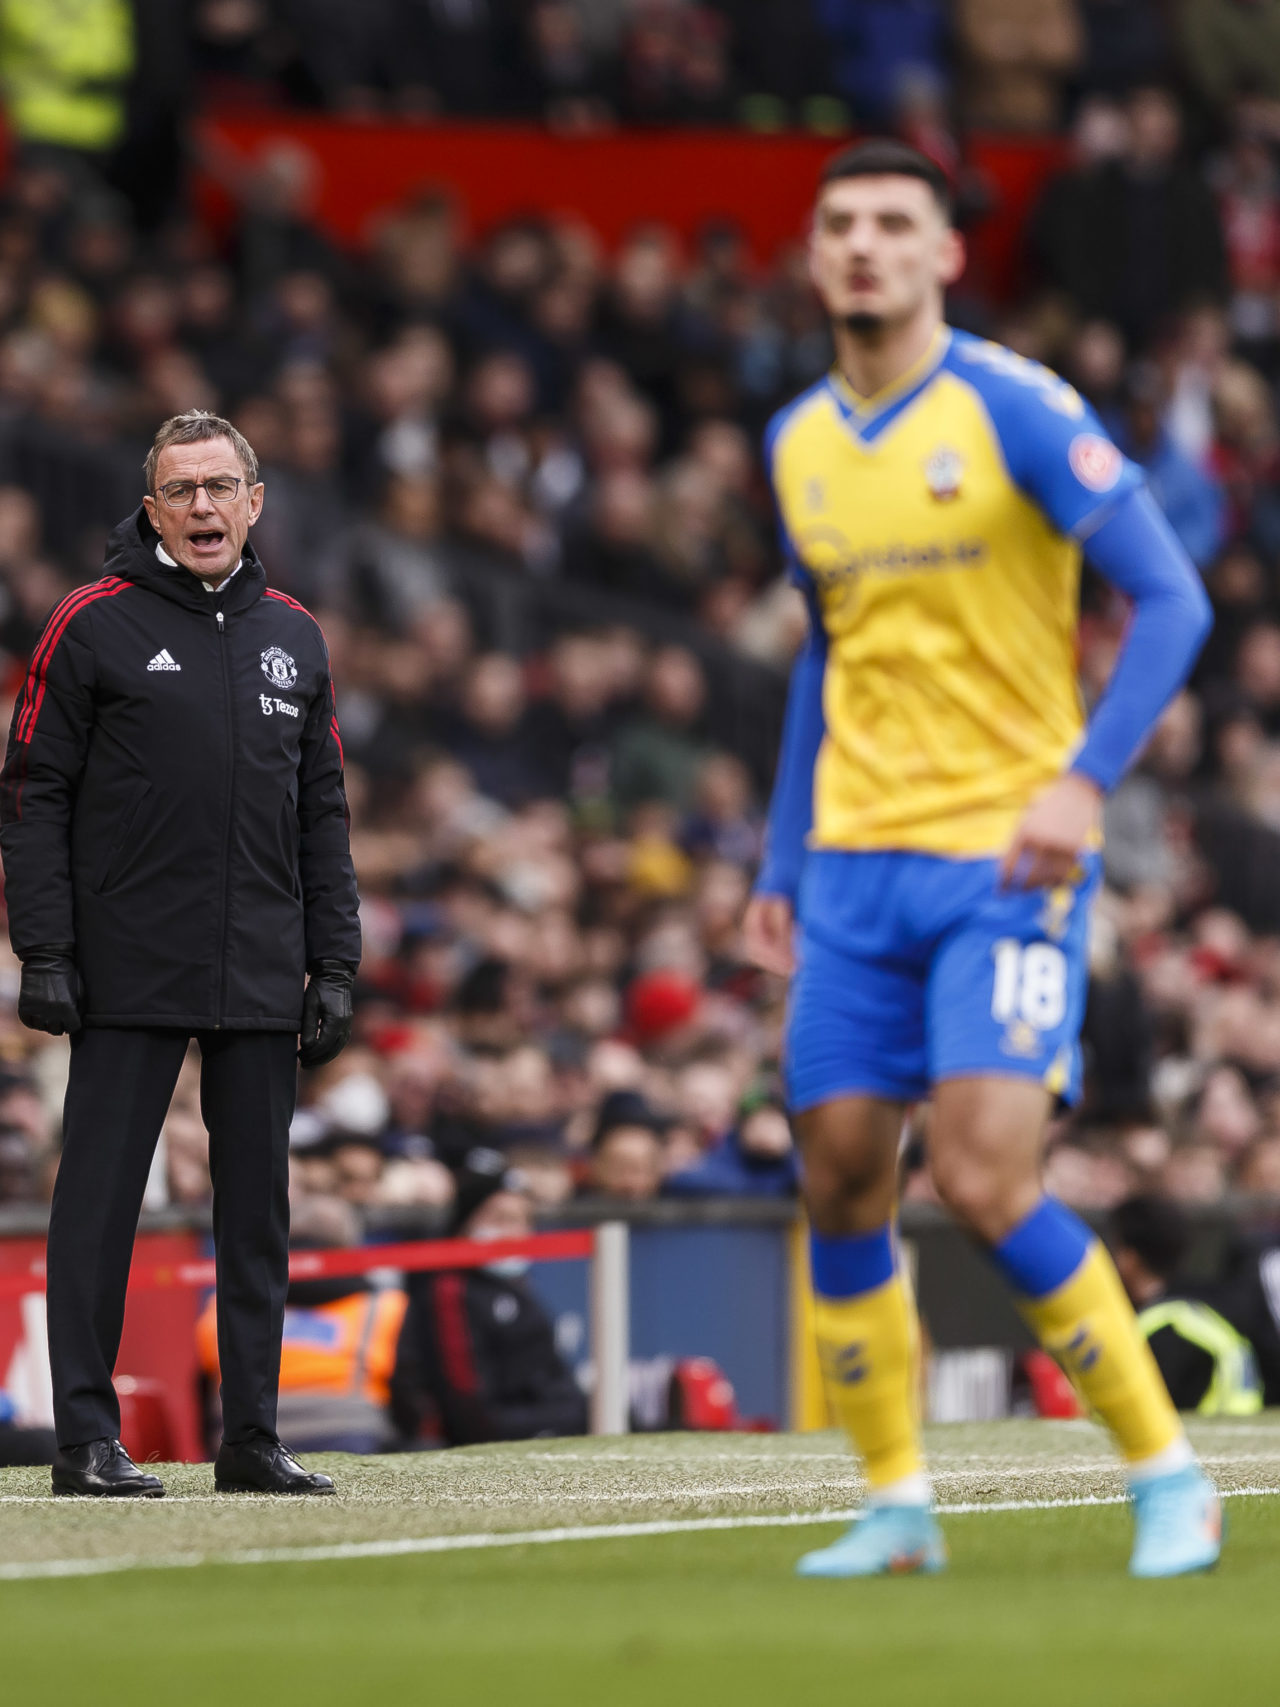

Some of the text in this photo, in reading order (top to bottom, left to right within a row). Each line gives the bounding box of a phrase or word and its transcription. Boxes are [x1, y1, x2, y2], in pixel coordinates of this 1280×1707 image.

[263, 649, 293, 666] MANCHESTER
[146, 662, 182, 671] adidas
[271, 676, 293, 686] UNITED
[273, 698, 299, 718] Tezos
[990, 936, 1068, 1031] 18
